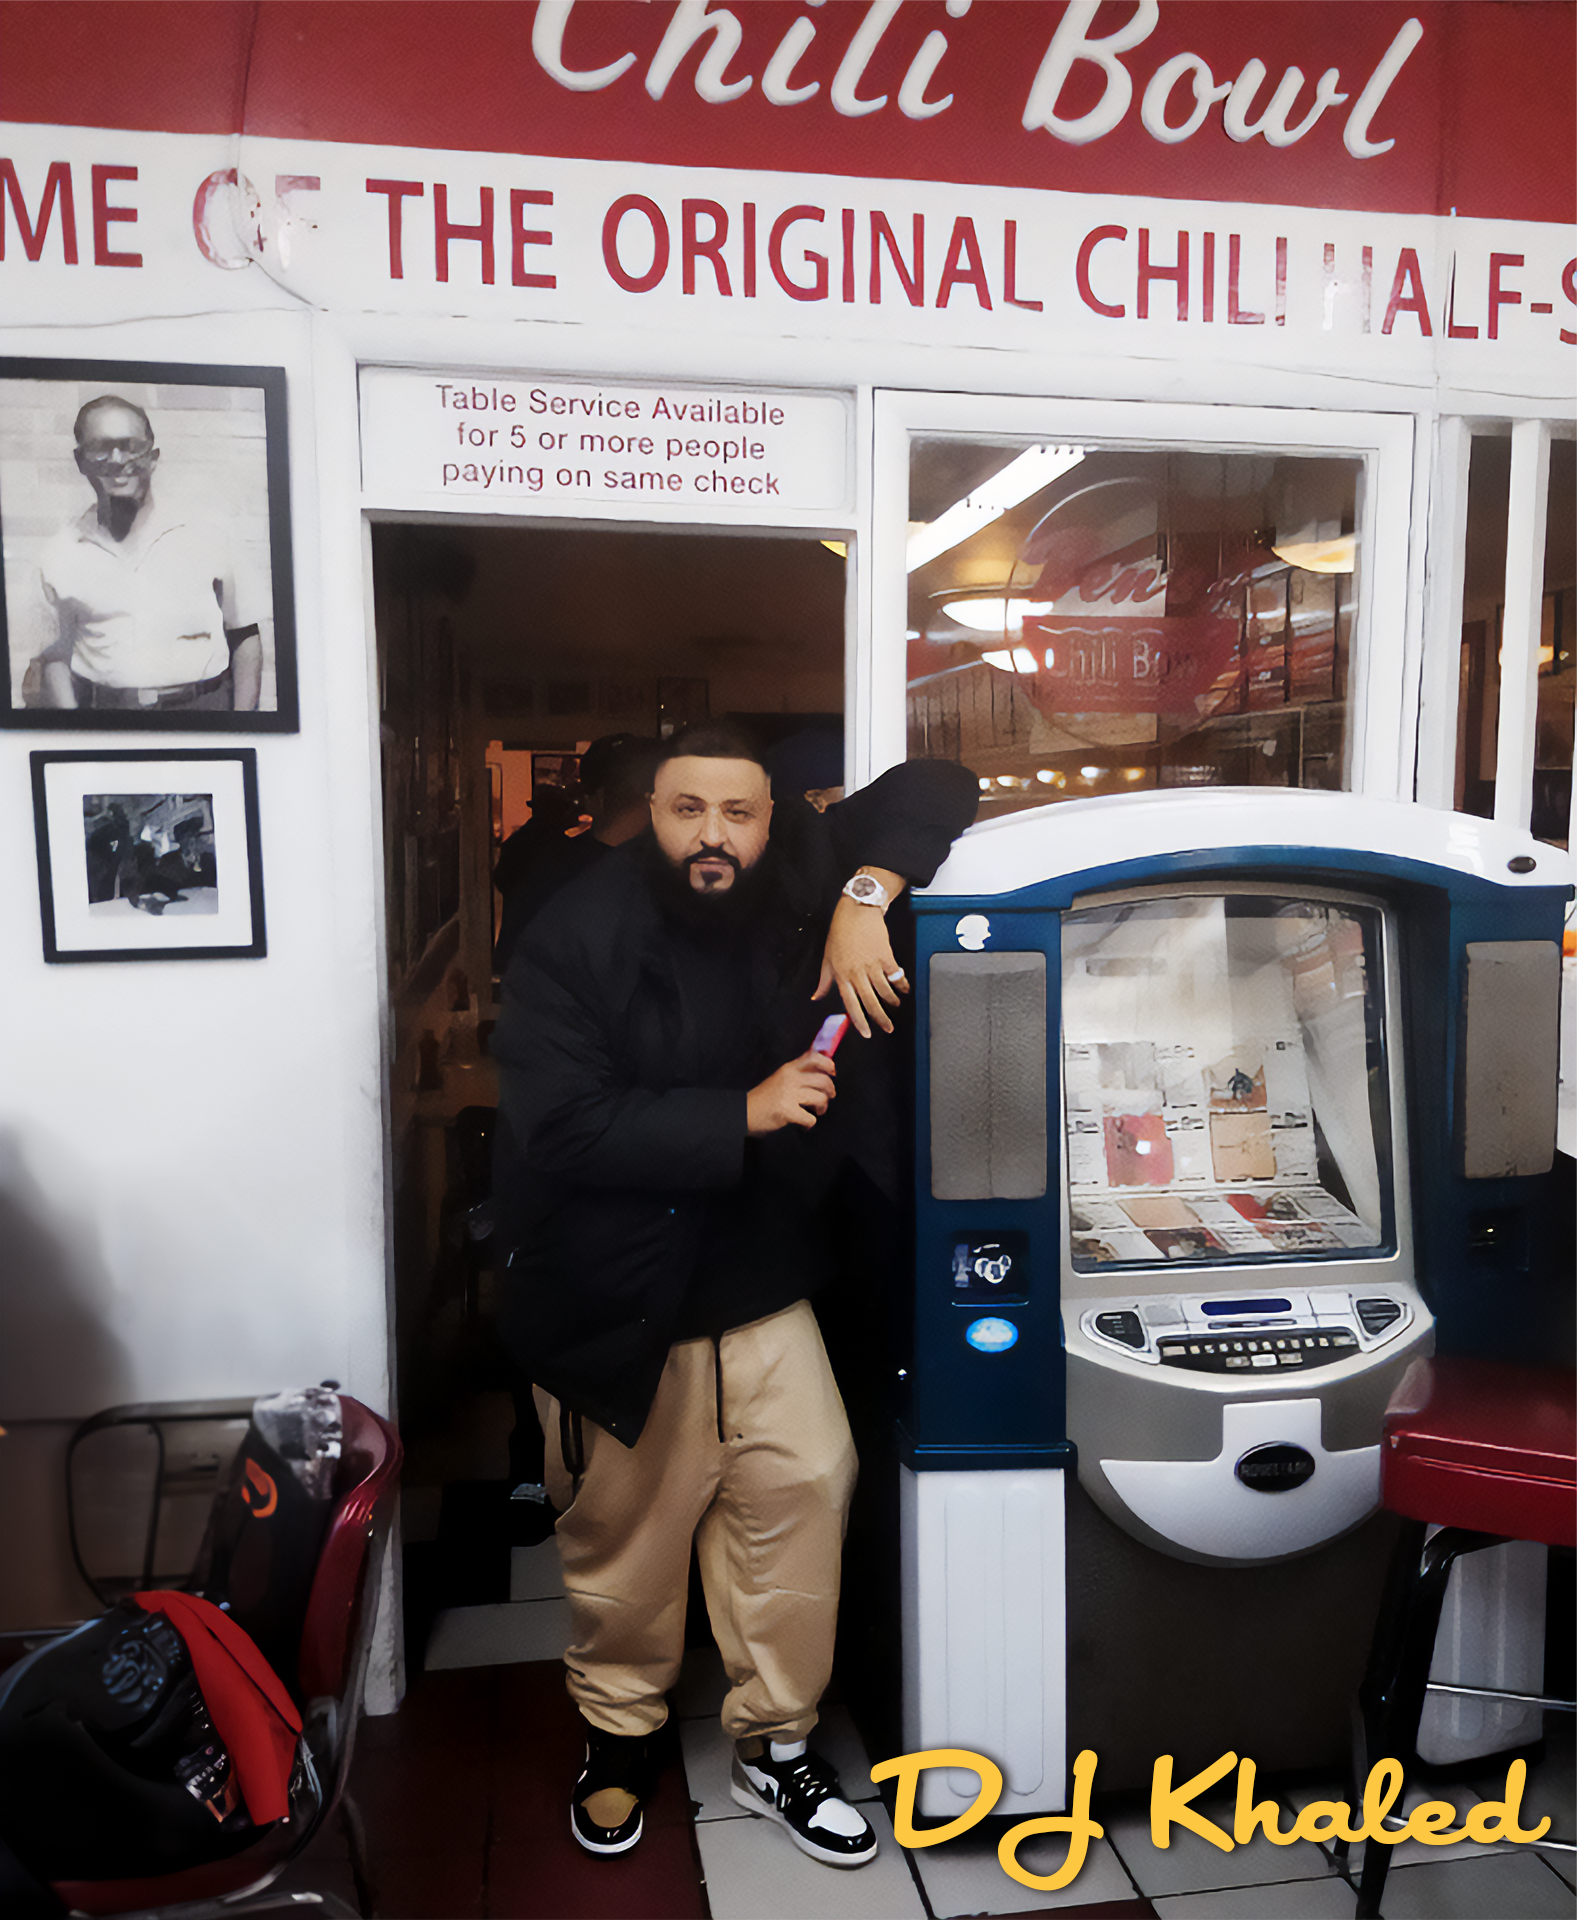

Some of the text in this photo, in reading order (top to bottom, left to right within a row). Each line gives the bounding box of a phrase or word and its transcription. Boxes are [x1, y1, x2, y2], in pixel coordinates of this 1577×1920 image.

[532, 0, 1424, 159] Chili Bowl
[0, 157, 143, 268] ME
[365, 178, 557, 290] THE
[601, 193, 1044, 313] ORIGINAL
[1075, 224, 1287, 327] CHILI
[434, 384, 785, 426] Table Service Available
[457, 421, 766, 464] for 5 or more people
[442, 459, 780, 496] paying on same check
